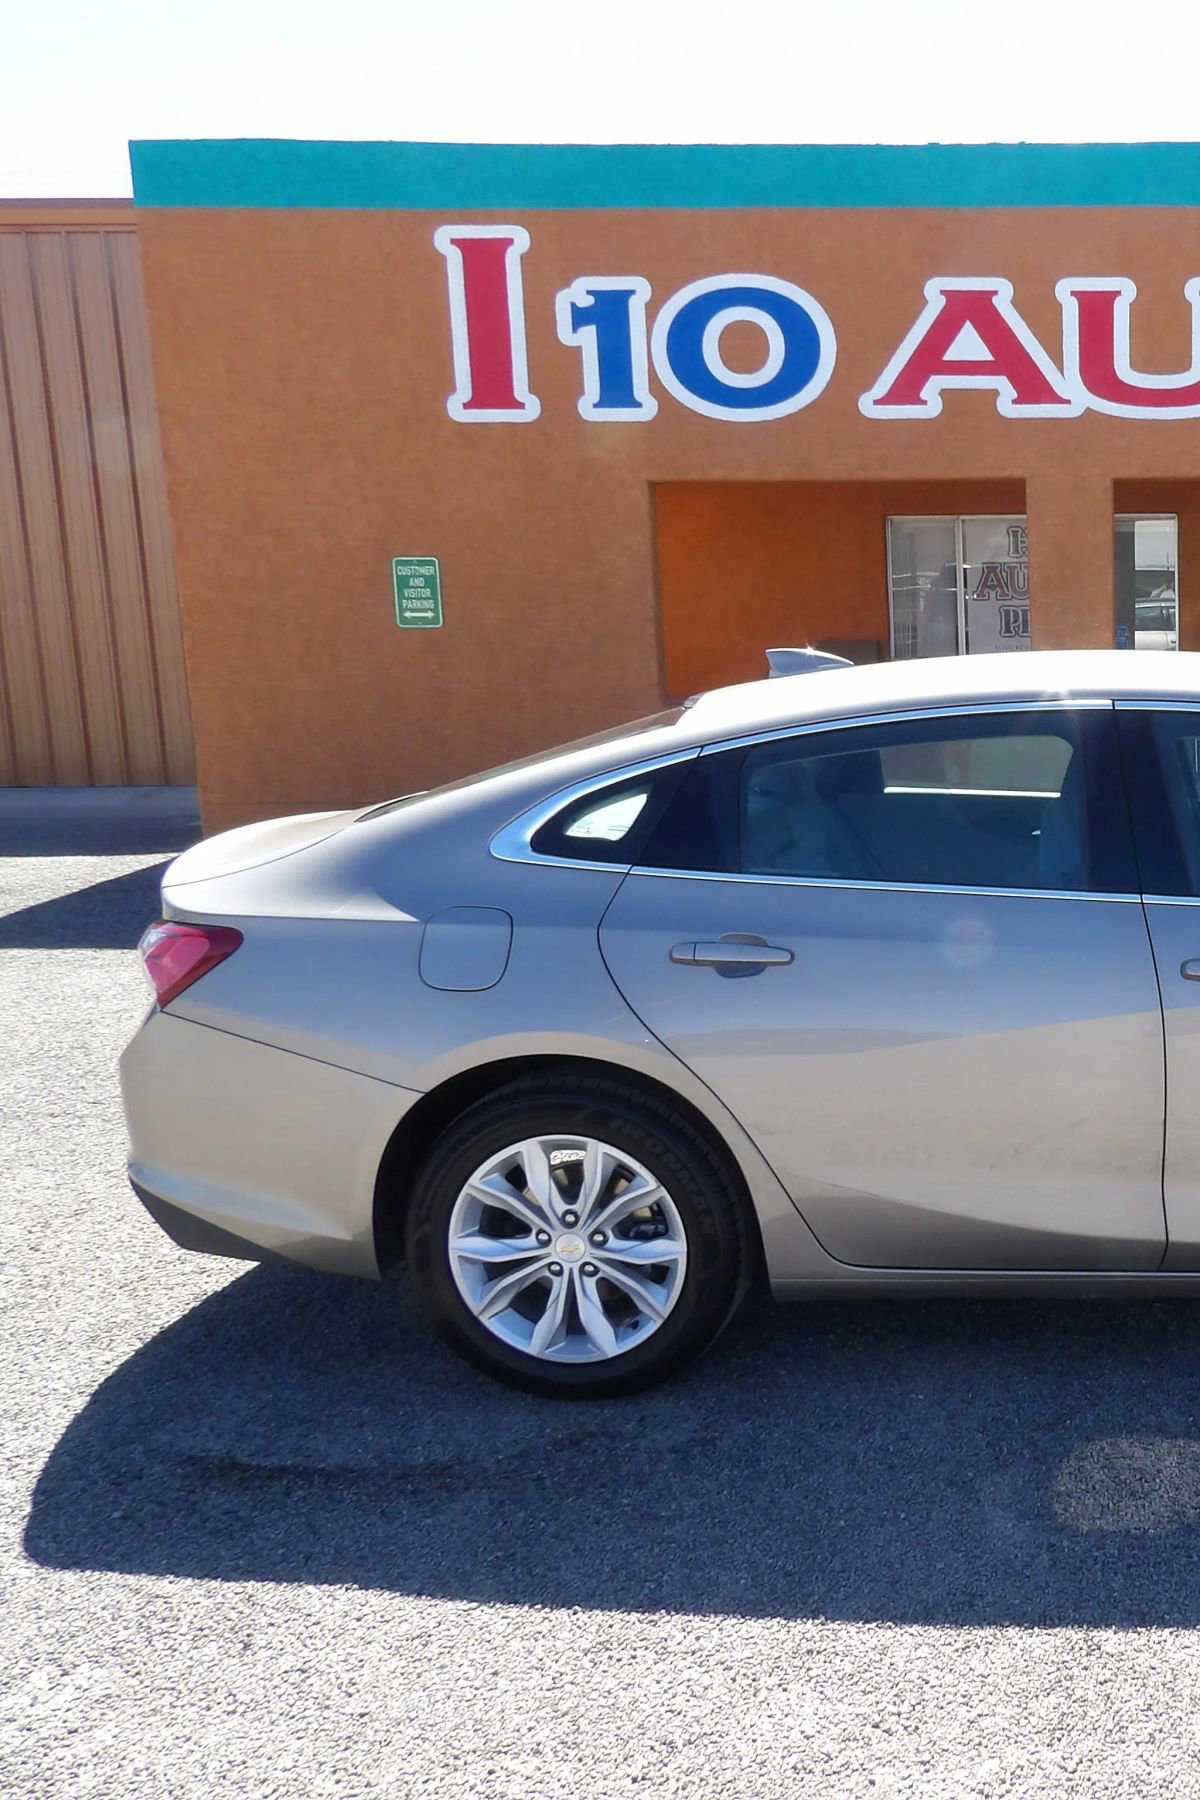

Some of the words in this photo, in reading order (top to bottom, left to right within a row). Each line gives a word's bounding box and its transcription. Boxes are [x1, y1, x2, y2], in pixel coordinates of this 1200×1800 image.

[396, 565, 435, 576] CUSTOMER
[408, 577, 425, 587] AND
[973, 562, 1030, 601] AU
[403, 588, 432, 598] VISITOR
[402, 599, 435, 609] PARKING
